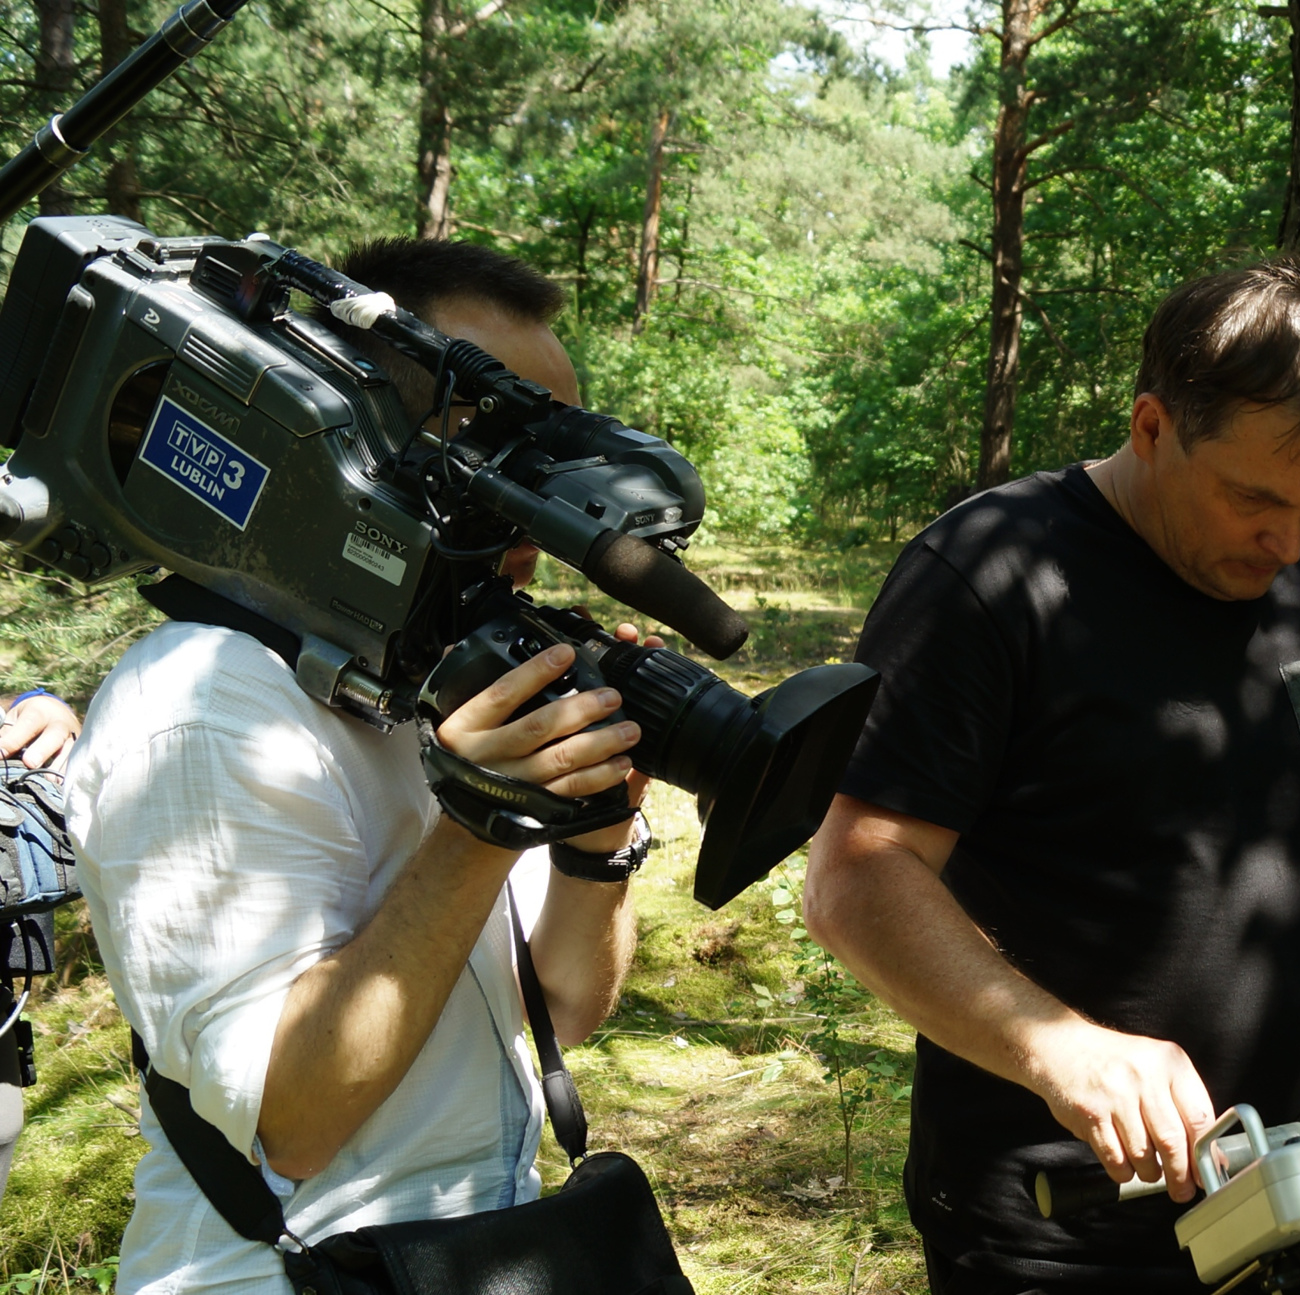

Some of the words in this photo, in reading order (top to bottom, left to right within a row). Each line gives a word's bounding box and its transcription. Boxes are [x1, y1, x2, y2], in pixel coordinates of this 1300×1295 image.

[170, 455, 226, 501] LUBLIN
[634, 513, 655, 526] SONY
[354, 520, 408, 554] SONY
[332, 599, 354, 616] Power
[353, 611, 369, 625] HAD
[463, 772, 528, 805] Canon
